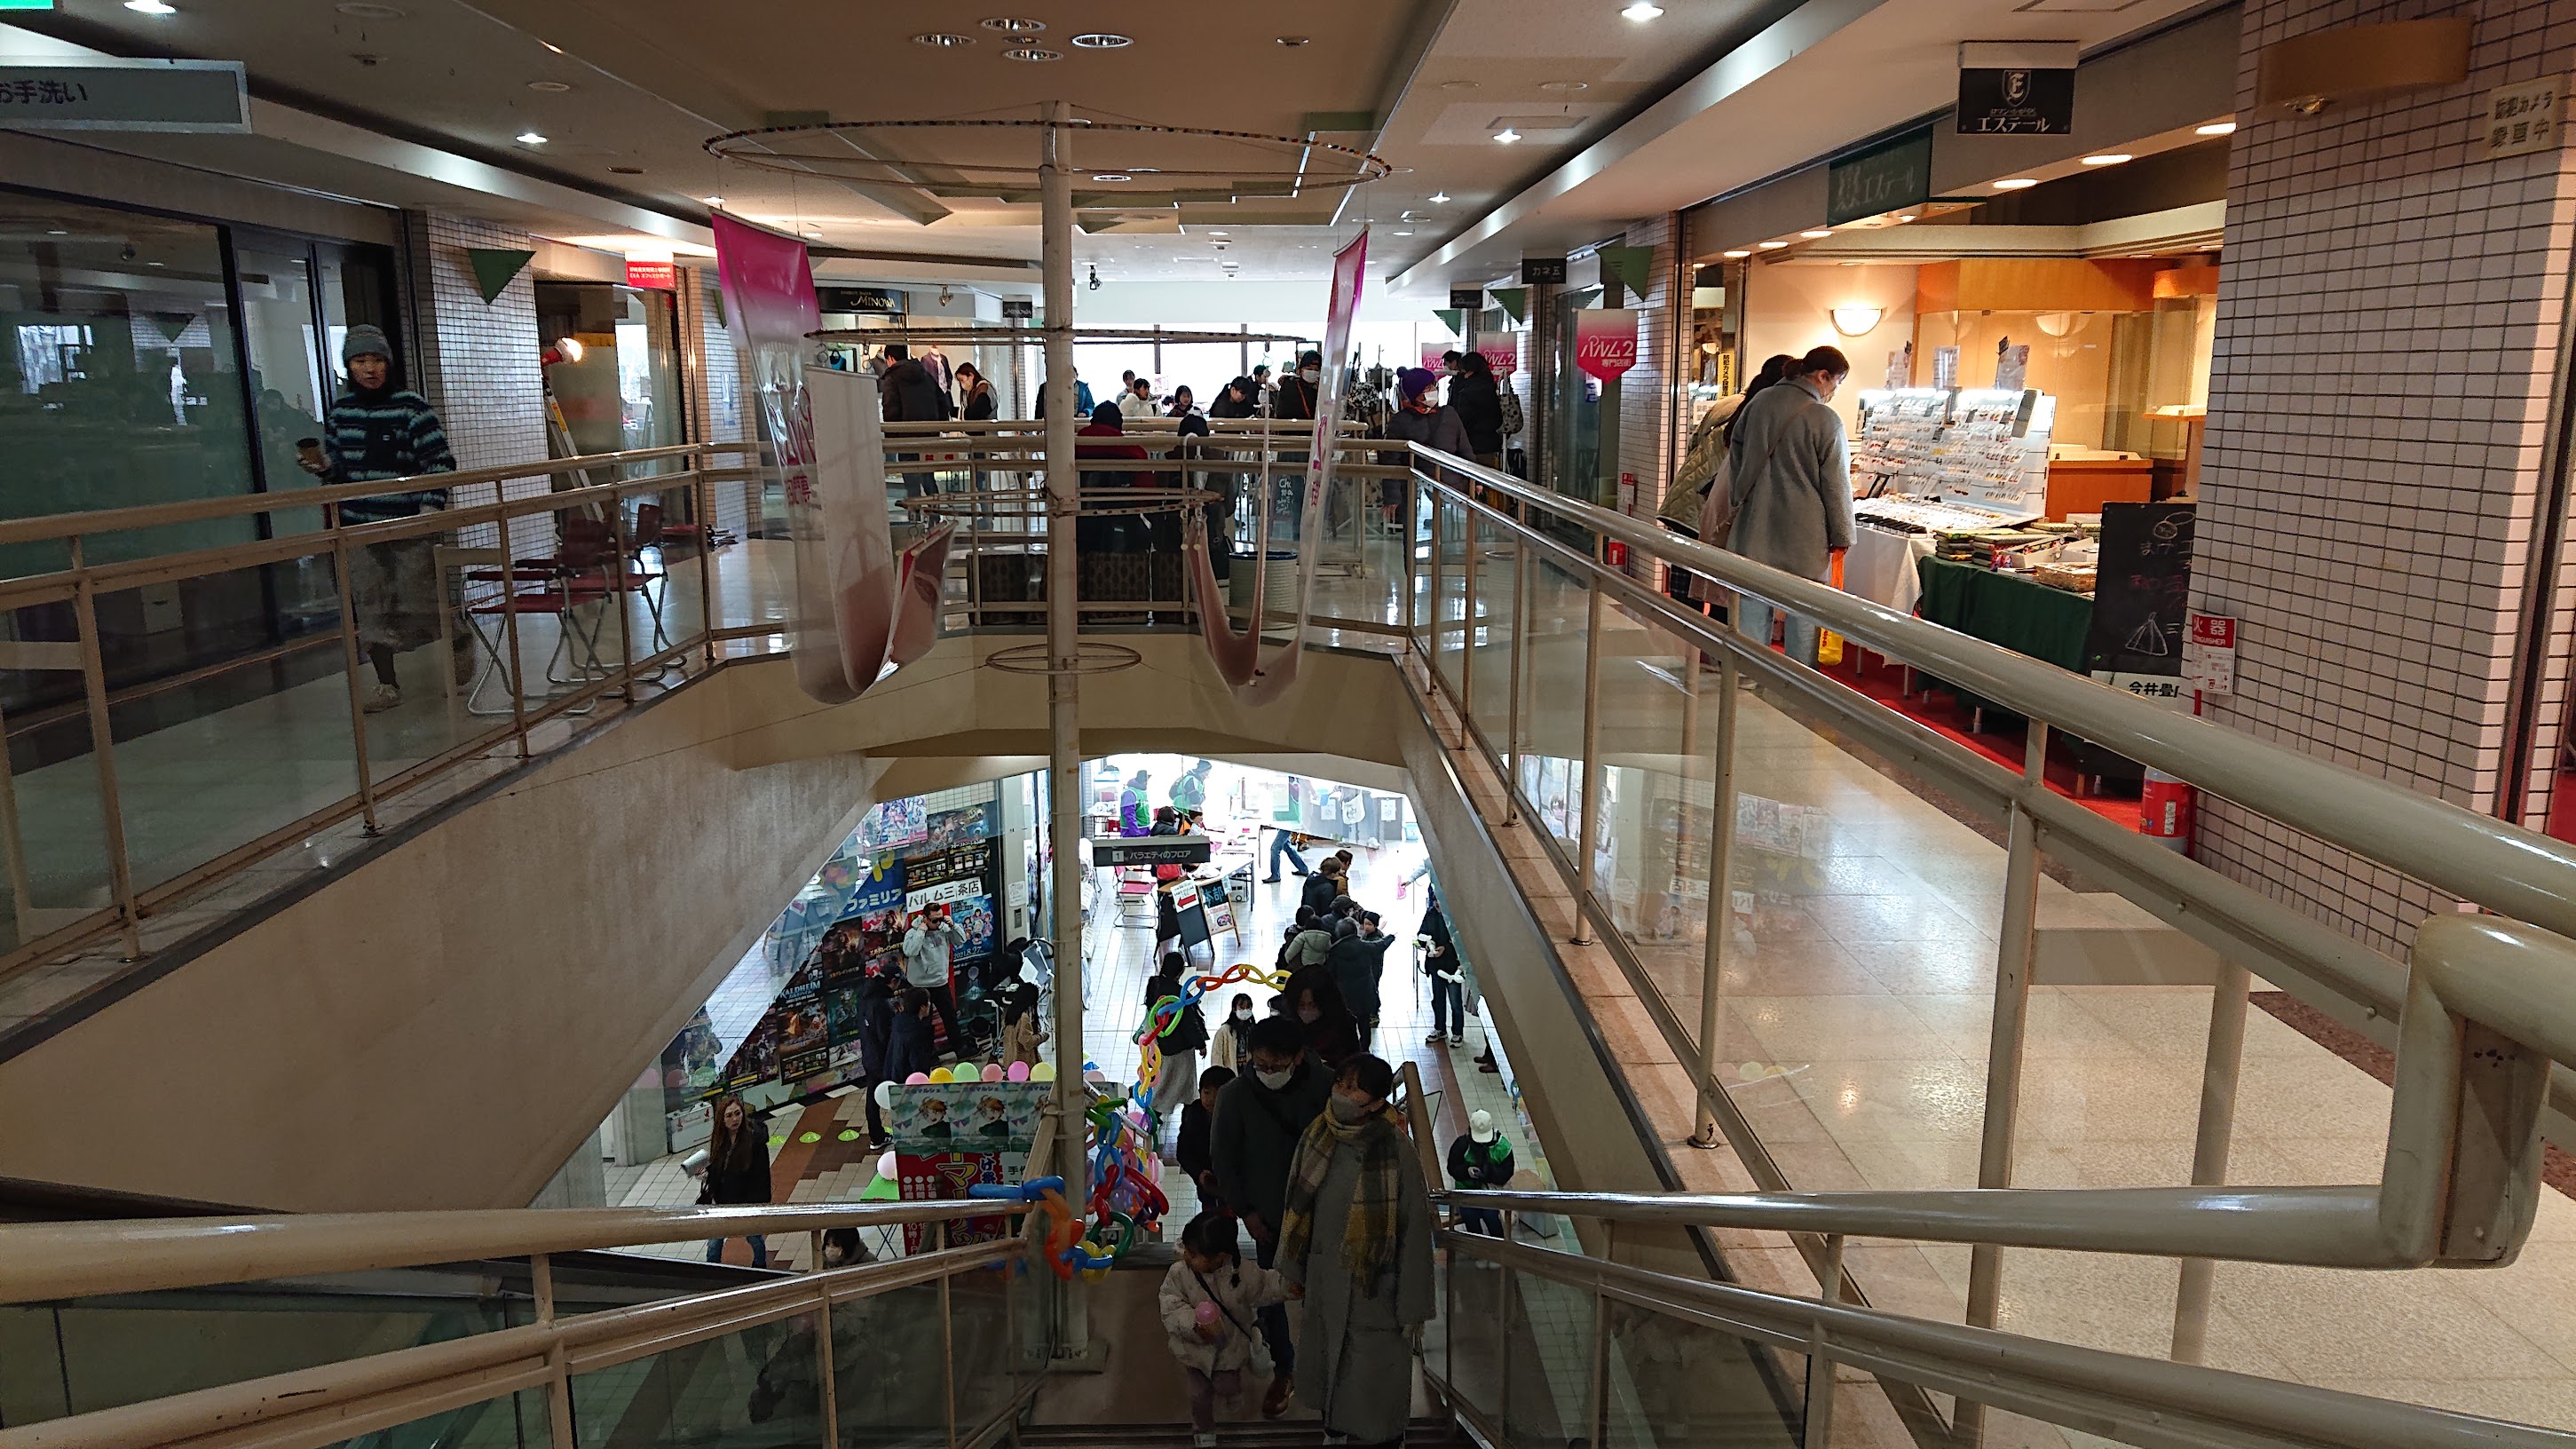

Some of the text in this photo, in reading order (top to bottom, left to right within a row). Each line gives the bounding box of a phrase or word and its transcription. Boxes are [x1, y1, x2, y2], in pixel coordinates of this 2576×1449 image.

[1977, 116, 2051, 133] エステール
[849, 295, 896, 307] MINOWA
[1130, 850, 1191, 859] バラエティのフロア
[848, 888, 902, 912] ファミリア
[908, 881, 980, 907] パルム三条店
[779, 980, 821, 999] KALDHEIM
